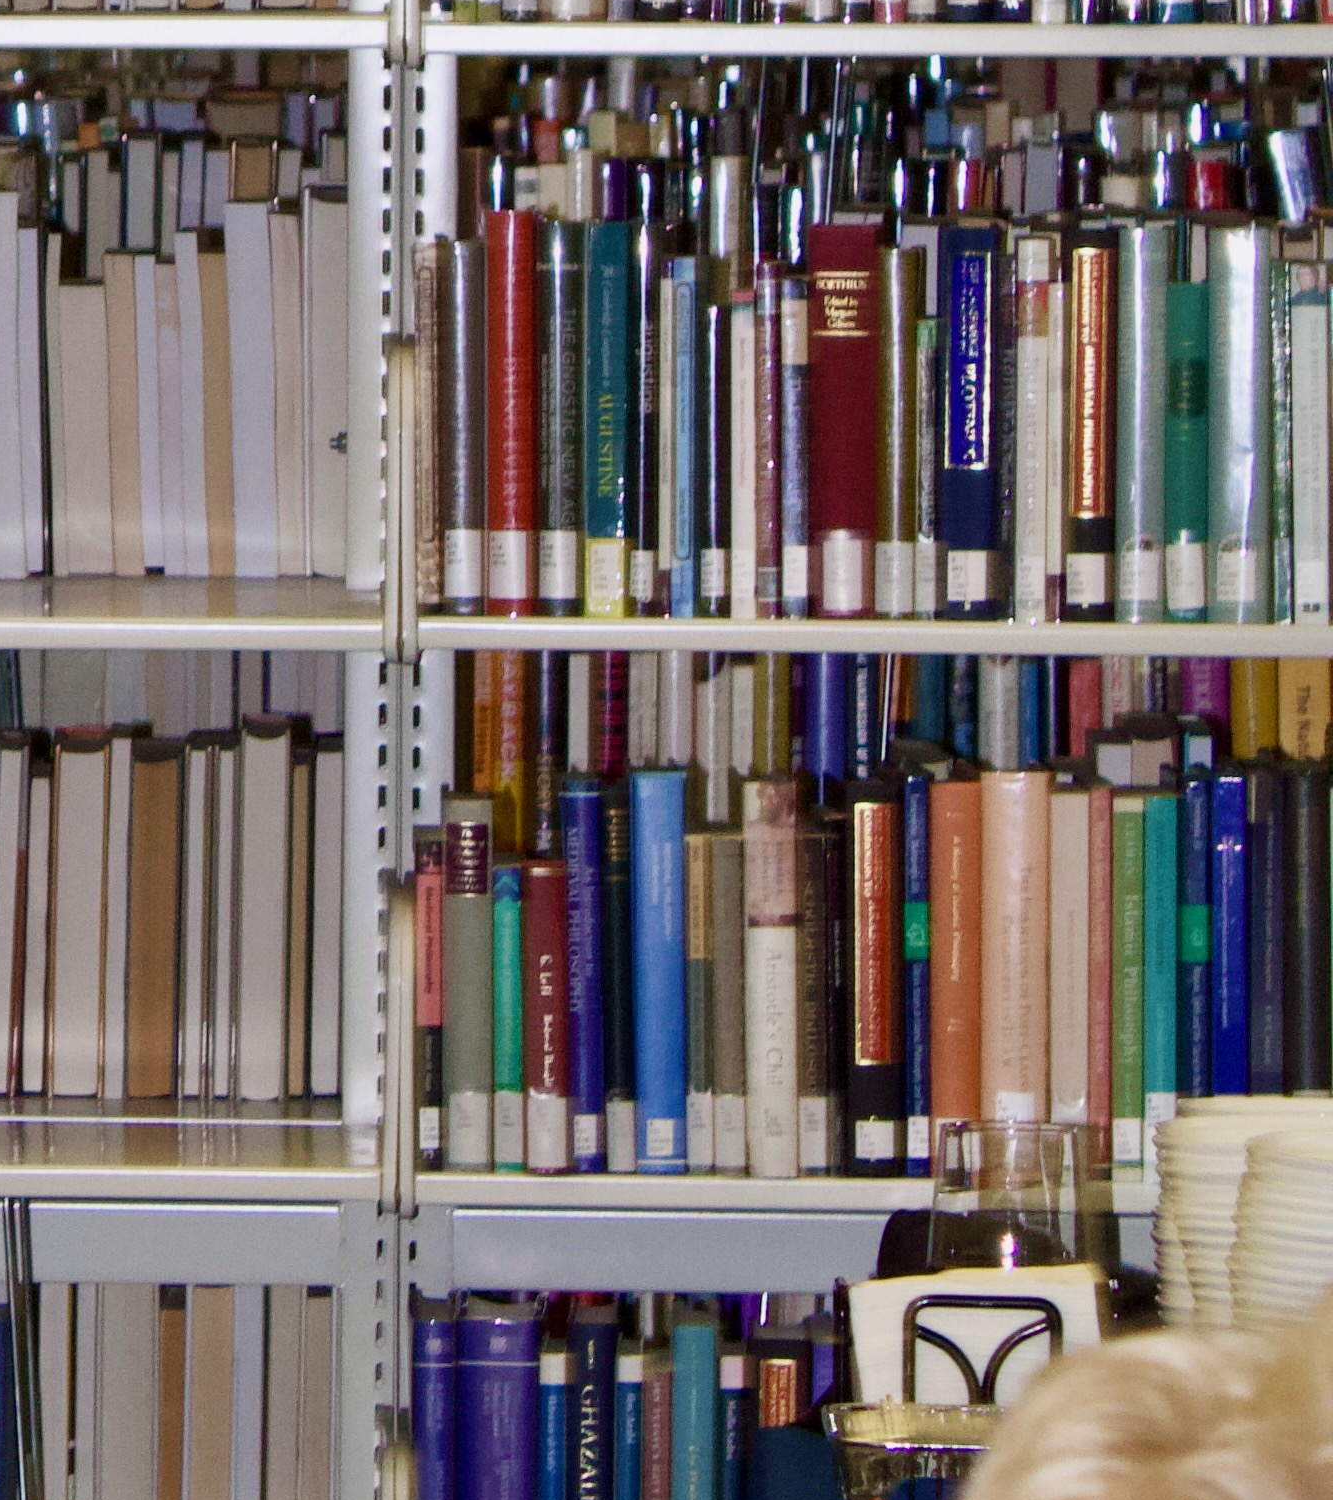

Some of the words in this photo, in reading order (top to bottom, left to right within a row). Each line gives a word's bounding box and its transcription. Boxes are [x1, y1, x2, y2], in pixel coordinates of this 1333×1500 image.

[562, 309, 576, 346] THE
[561, 353, 576, 438] GNOSTIC
[561, 444, 575, 489] NEW
[598, 392, 613, 498] AUGUSTINE
[567, 827, 580, 903] MEDIEVAL
[568, 909, 581, 1014] PHILOSOPHY
[1124, 894, 1138, 956] Islamic
[1119, 967, 1138, 1064] Philosophy
